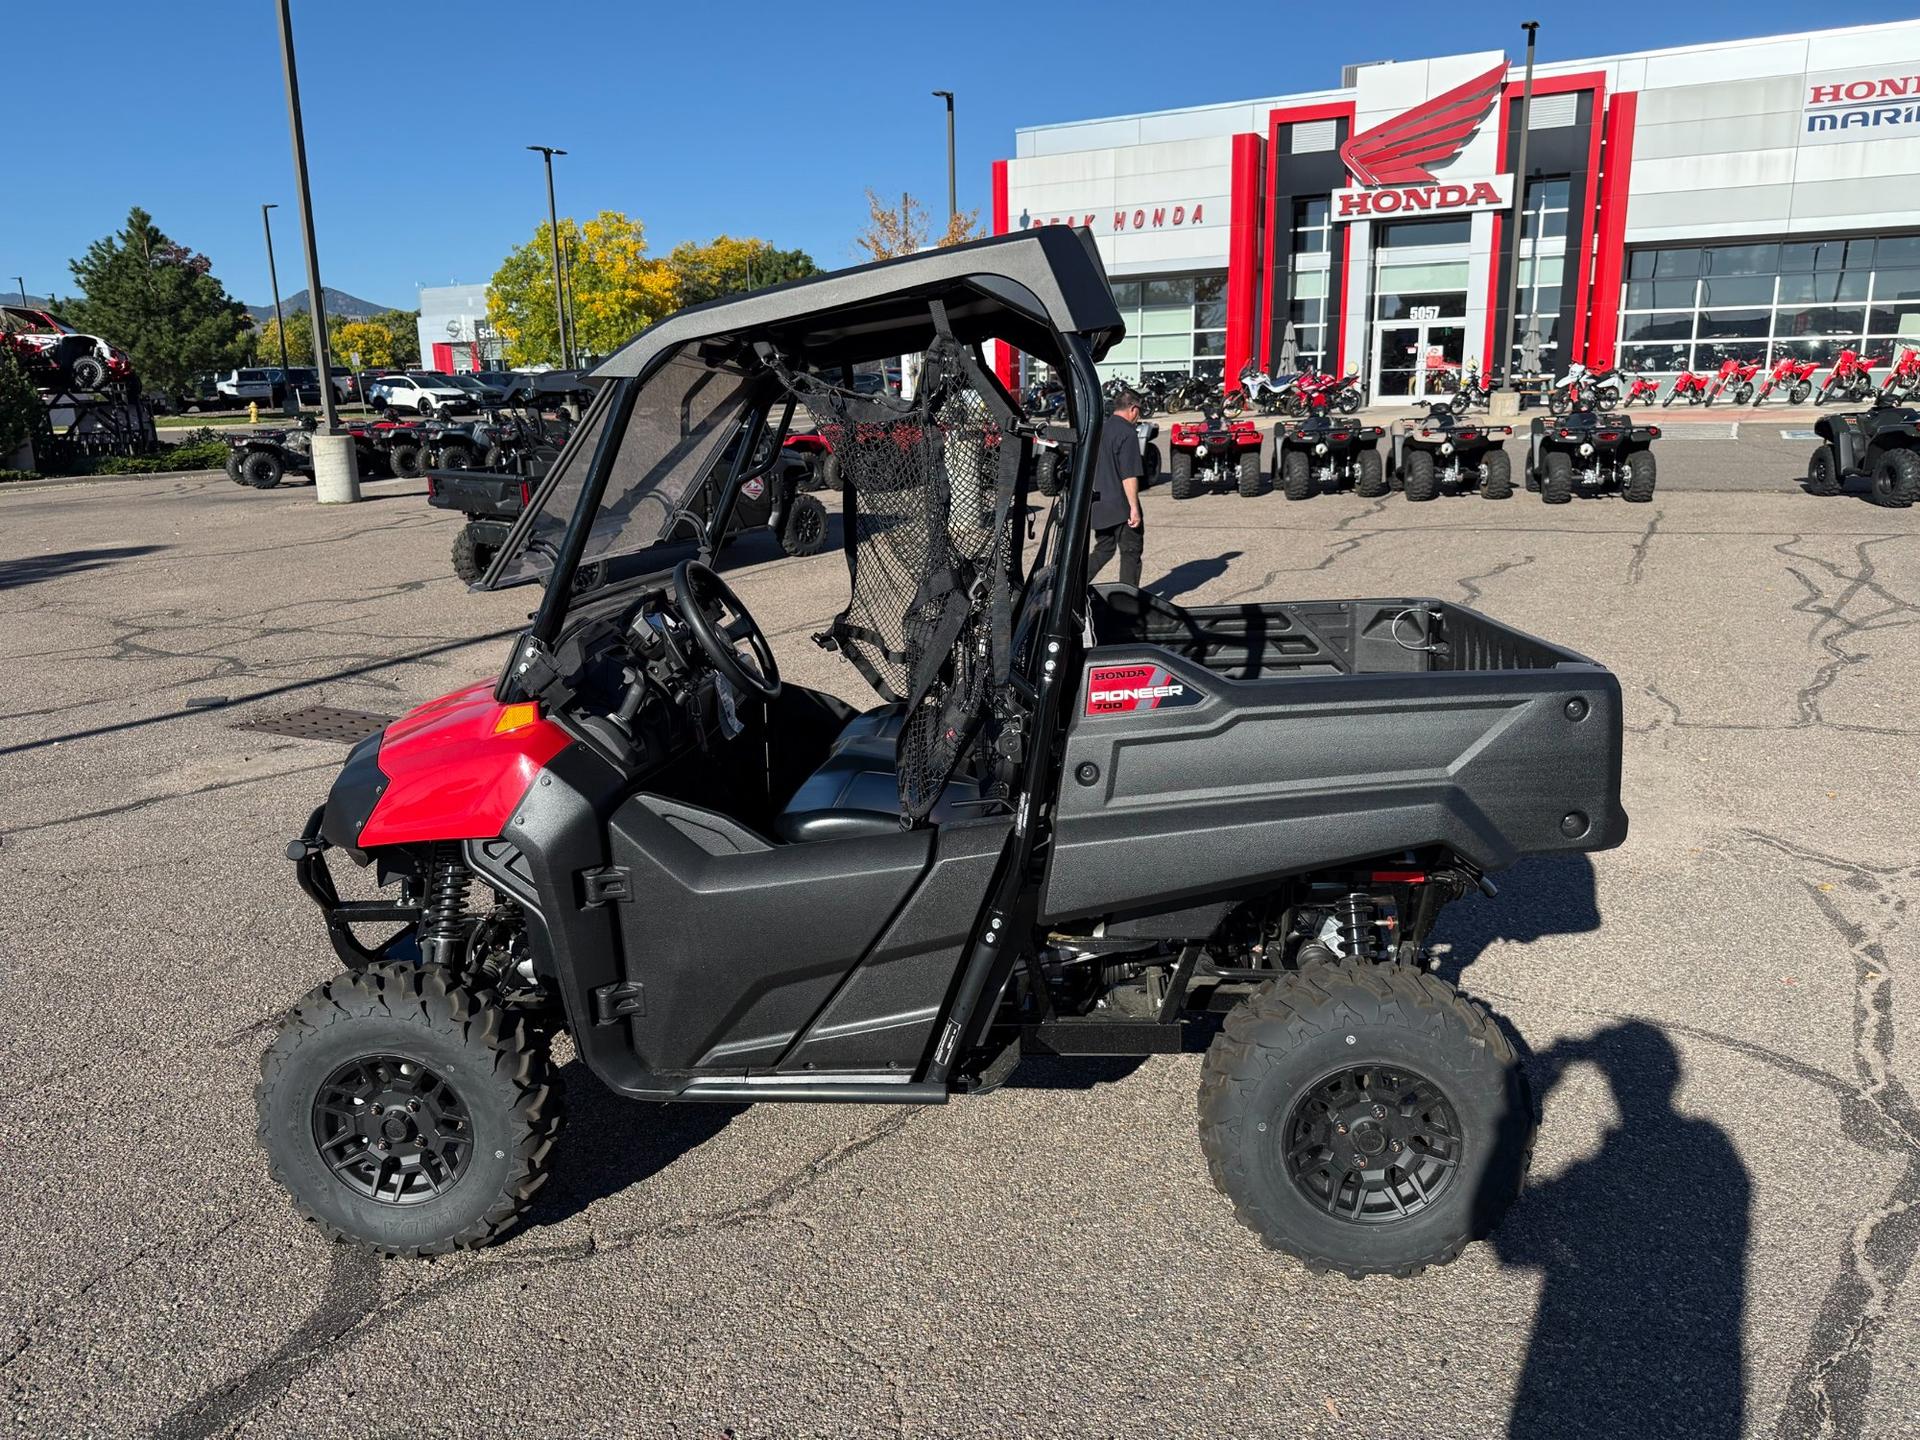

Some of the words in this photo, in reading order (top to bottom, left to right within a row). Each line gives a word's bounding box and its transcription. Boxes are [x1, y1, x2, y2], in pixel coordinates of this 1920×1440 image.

[1808, 76, 1920, 104] HON
[1807, 106, 1920, 132] MARI
[1338, 182, 1502, 216] HONDA
[1113, 204, 1203, 231] HONDA
[1410, 306, 1440, 320] 5057
[1094, 669, 1147, 681] HONDA
[1091, 684, 1184, 703] PIONEER
[1094, 702, 1123, 710] 700
